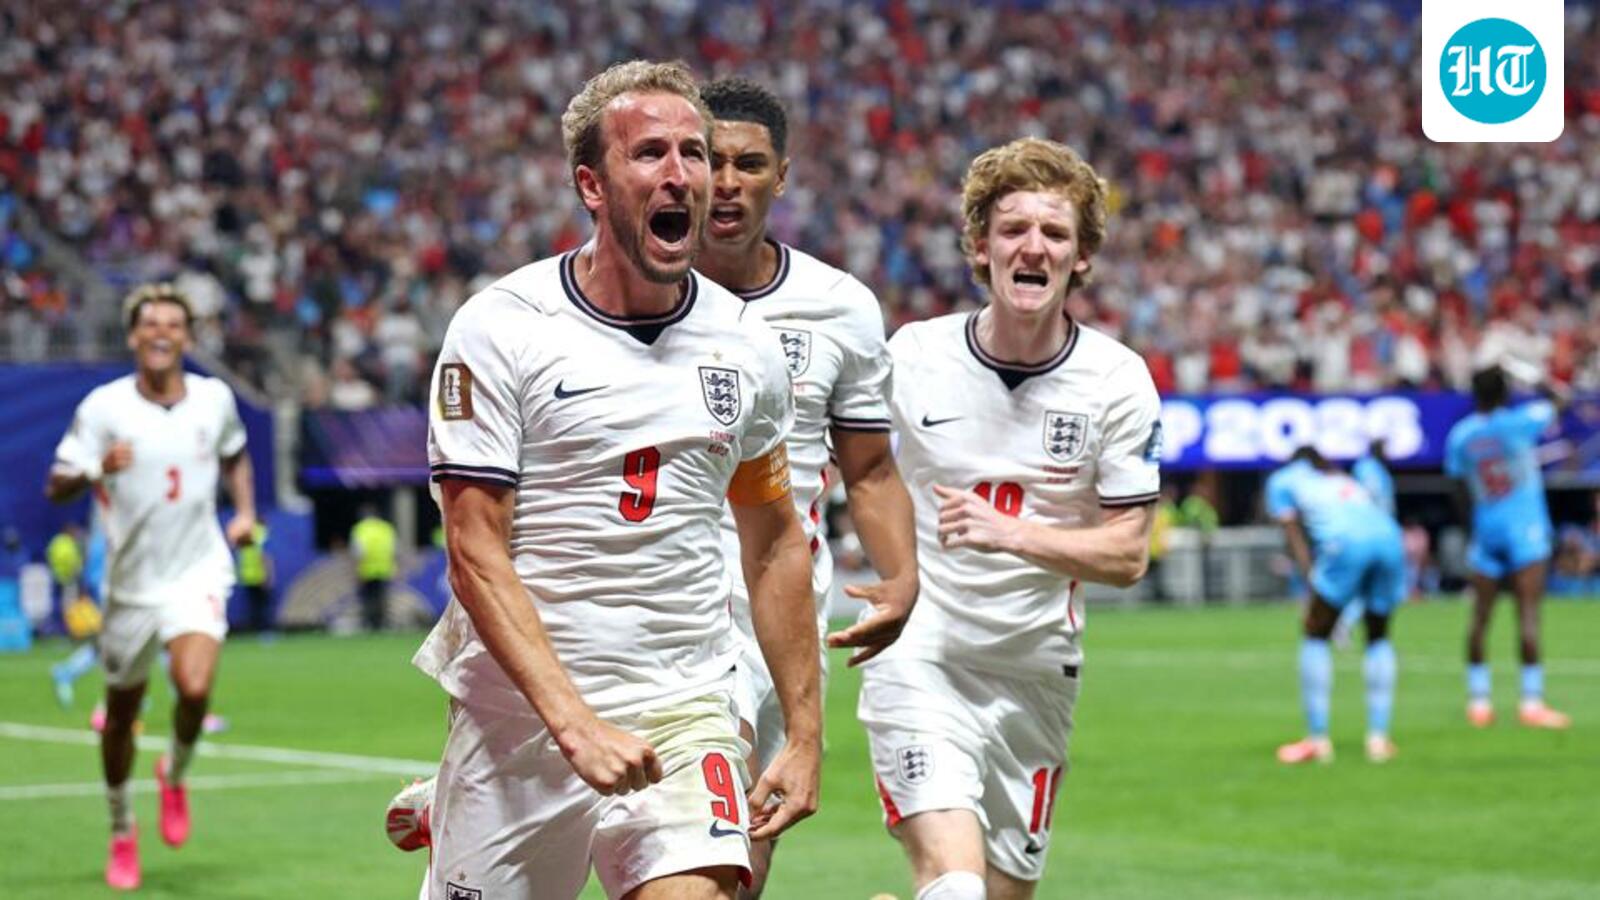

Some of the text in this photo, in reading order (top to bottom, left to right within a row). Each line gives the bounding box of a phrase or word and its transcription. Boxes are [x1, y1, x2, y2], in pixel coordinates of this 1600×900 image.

[1205, 397, 1423, 462] 2026
[618, 446, 661, 523] 9
[701, 752, 740, 825] 9
